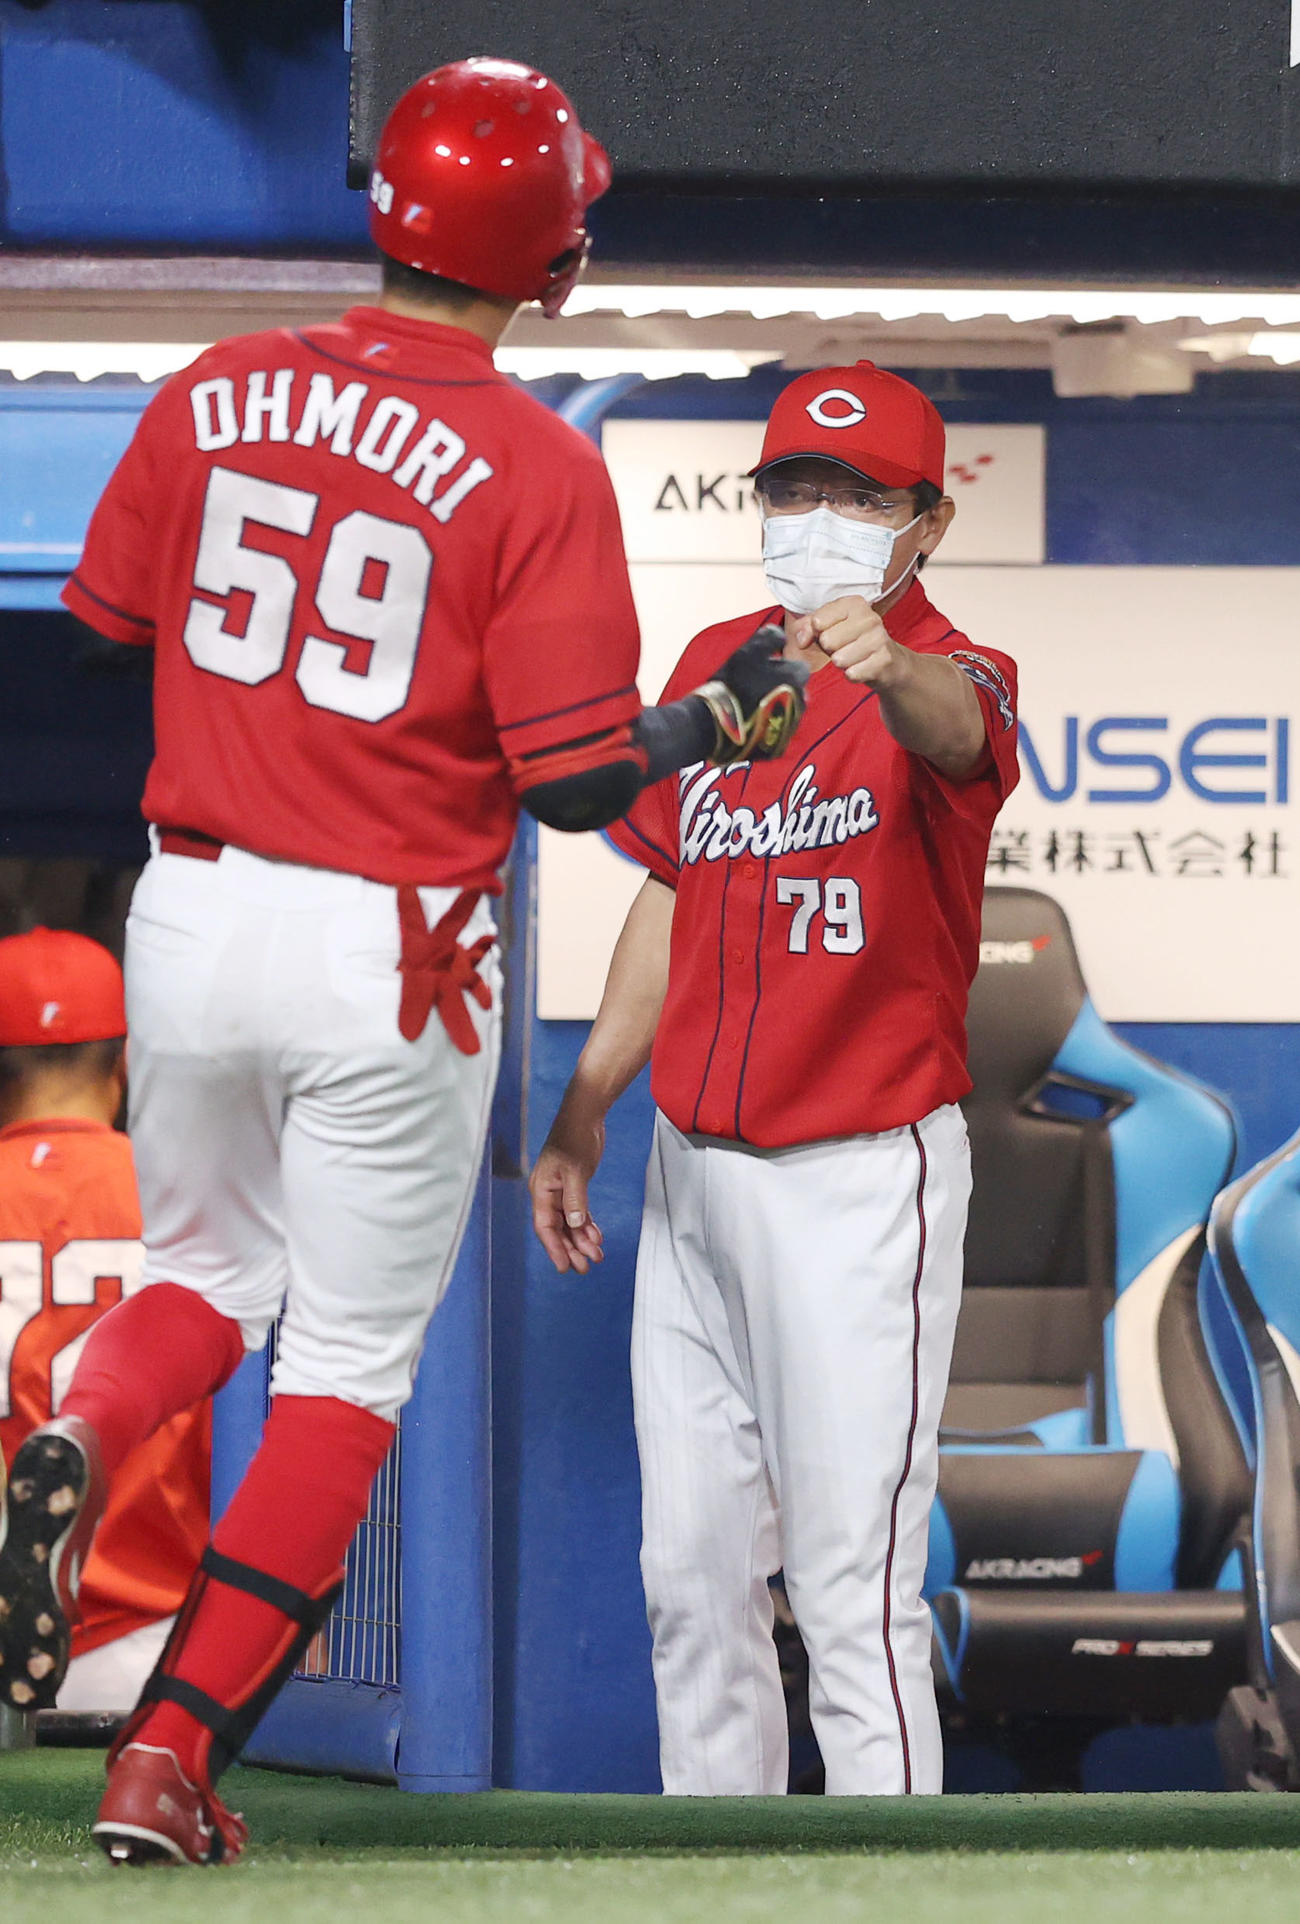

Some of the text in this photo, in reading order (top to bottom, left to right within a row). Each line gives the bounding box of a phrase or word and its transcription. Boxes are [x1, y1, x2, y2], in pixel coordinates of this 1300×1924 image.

[370, 171, 394, 214] 59
[190, 368, 493, 524] OHMORI
[805, 389, 867, 429] C
[183, 465, 434, 723] 59
[679, 761, 878, 868] Hiroshima
[776, 876, 865, 954] 79
